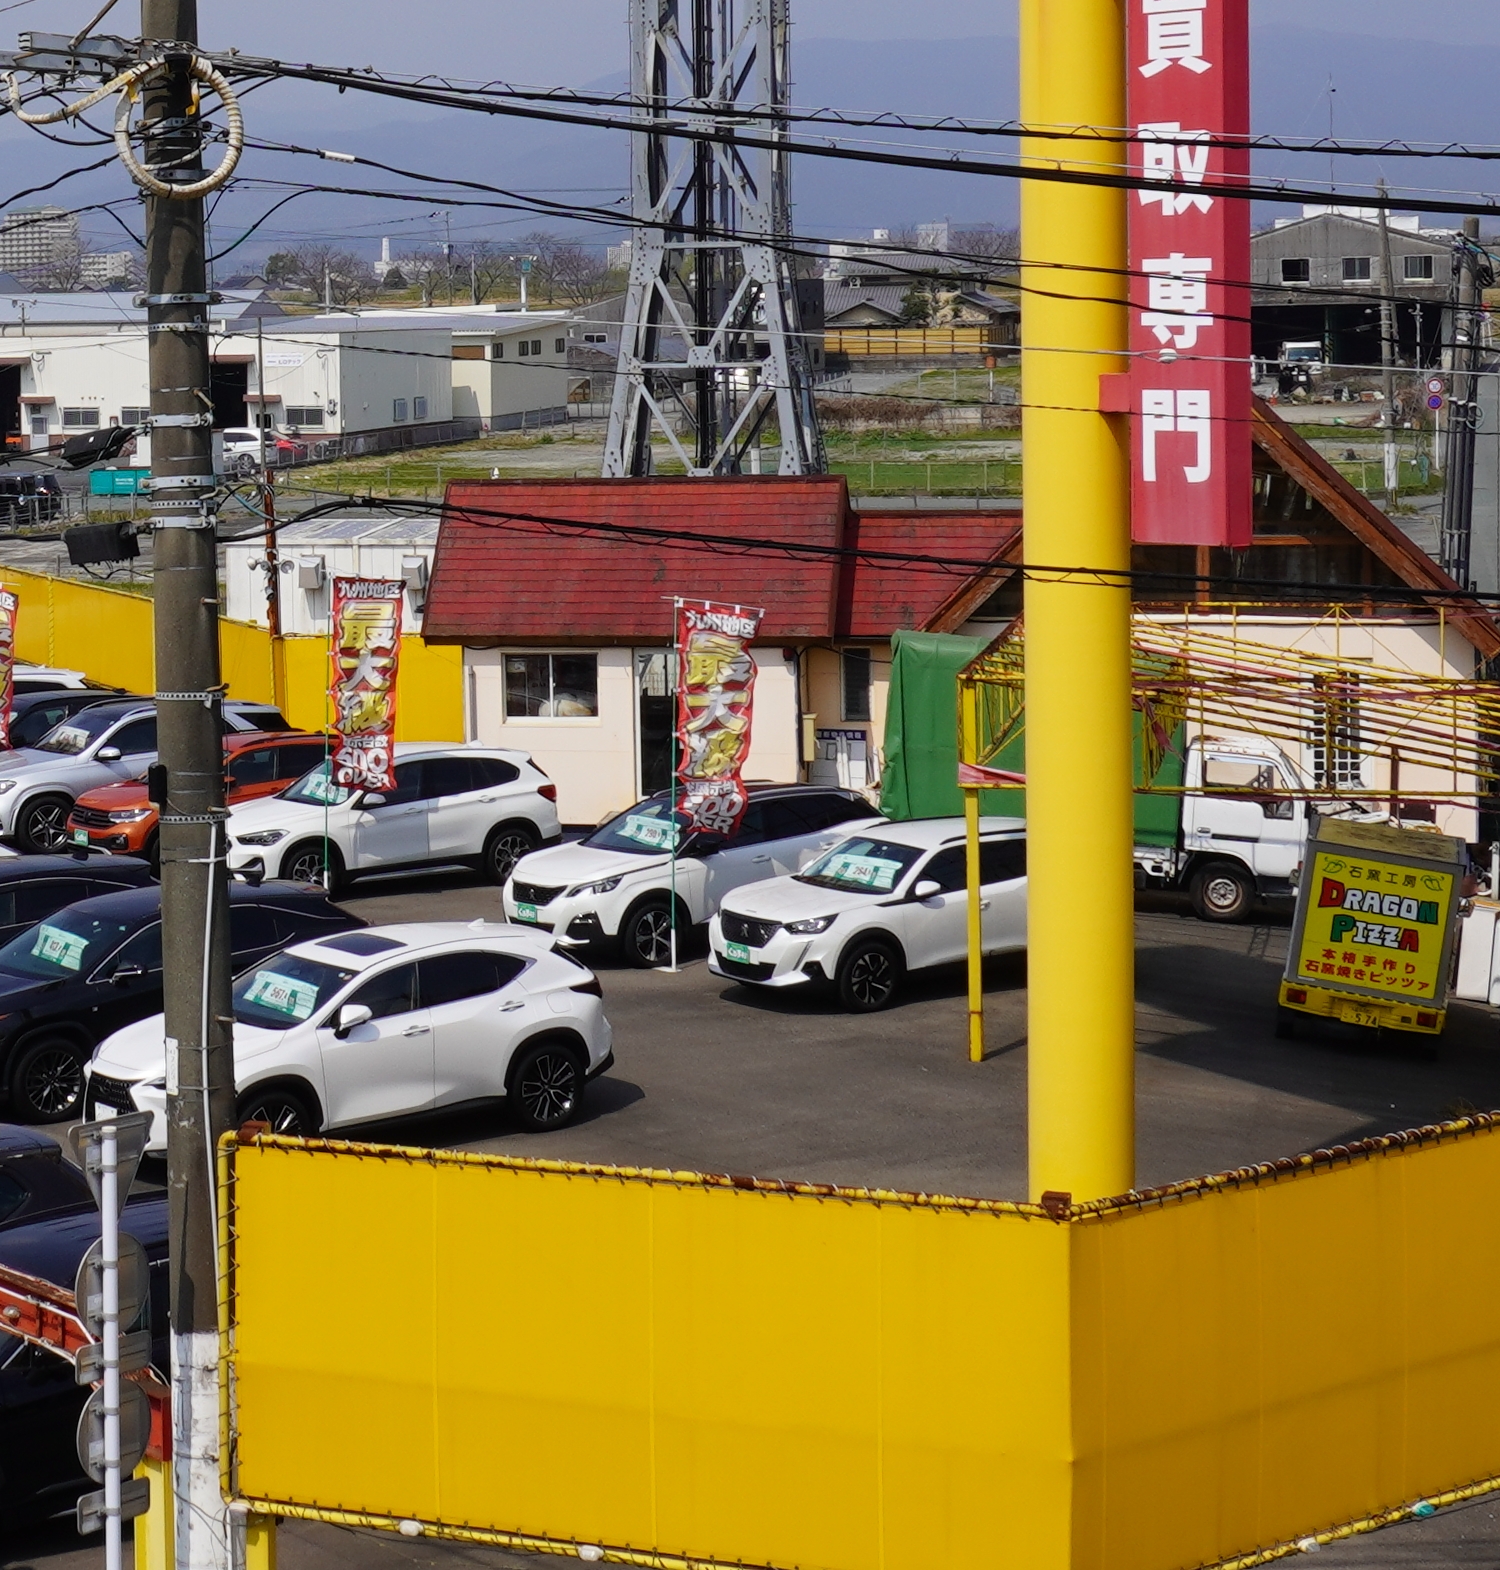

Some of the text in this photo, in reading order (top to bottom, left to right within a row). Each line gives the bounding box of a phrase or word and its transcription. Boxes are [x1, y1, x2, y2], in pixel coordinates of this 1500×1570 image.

[338, 581, 402, 598] 九州地区
[685, 610, 756, 638] 九州地区
[337, 601, 397, 734] 最大級
[684, 633, 754, 779] 最大級
[337, 747, 388, 772] 500
[337, 768, 391, 788] OVER
[1349, 865, 1417, 888] 石窯工房
[1318, 877, 1440, 925] DRAGON
[1330, 914, 1419, 952] PIZZA
[1305, 959, 1430, 991] 石窯焼きピッツァ
[1322, 948, 1417, 974] 本格手作り
